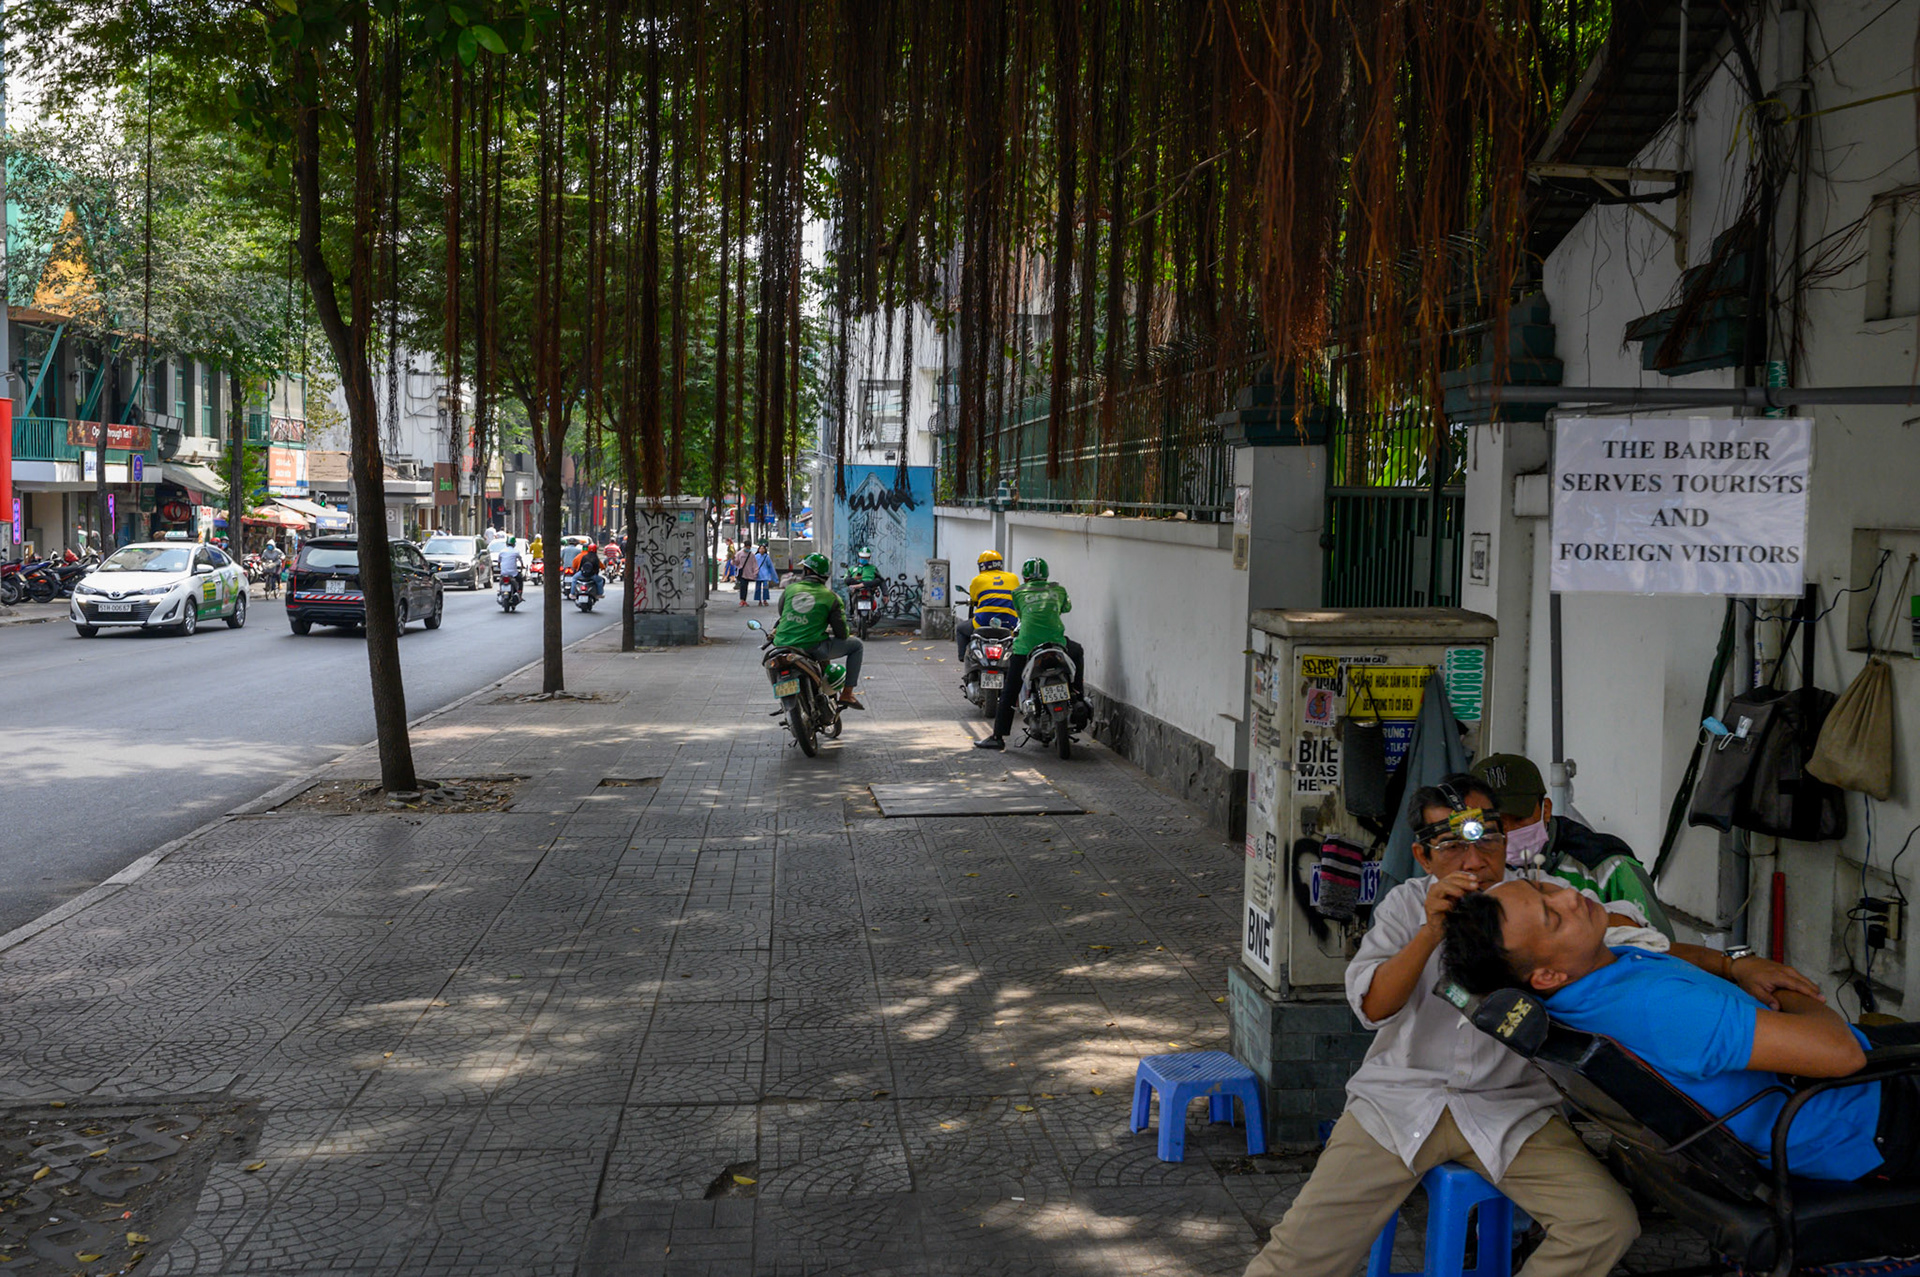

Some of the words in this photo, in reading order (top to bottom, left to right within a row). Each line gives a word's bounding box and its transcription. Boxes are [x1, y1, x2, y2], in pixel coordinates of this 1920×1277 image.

[107, 428, 123, 440] hrough
[1602, 440, 1655, 459] THE
[1662, 440, 1770, 460] BARBER
[1561, 472, 1662, 492] SERVES
[1672, 473, 1803, 494] TOURISTS
[1651, 507, 1710, 527] AND
[1559, 542, 1673, 562] FOREIGN
[1681, 544, 1800, 564] VISITORS
[1024, 588, 1060, 604] Grab
[786, 611, 809, 625] Grab
[1450, 649, 1484, 720] 0941.018.088
[1299, 740, 1338, 763] BNE
[1300, 765, 1338, 777] WAS
[1248, 906, 1271, 966] BNE
